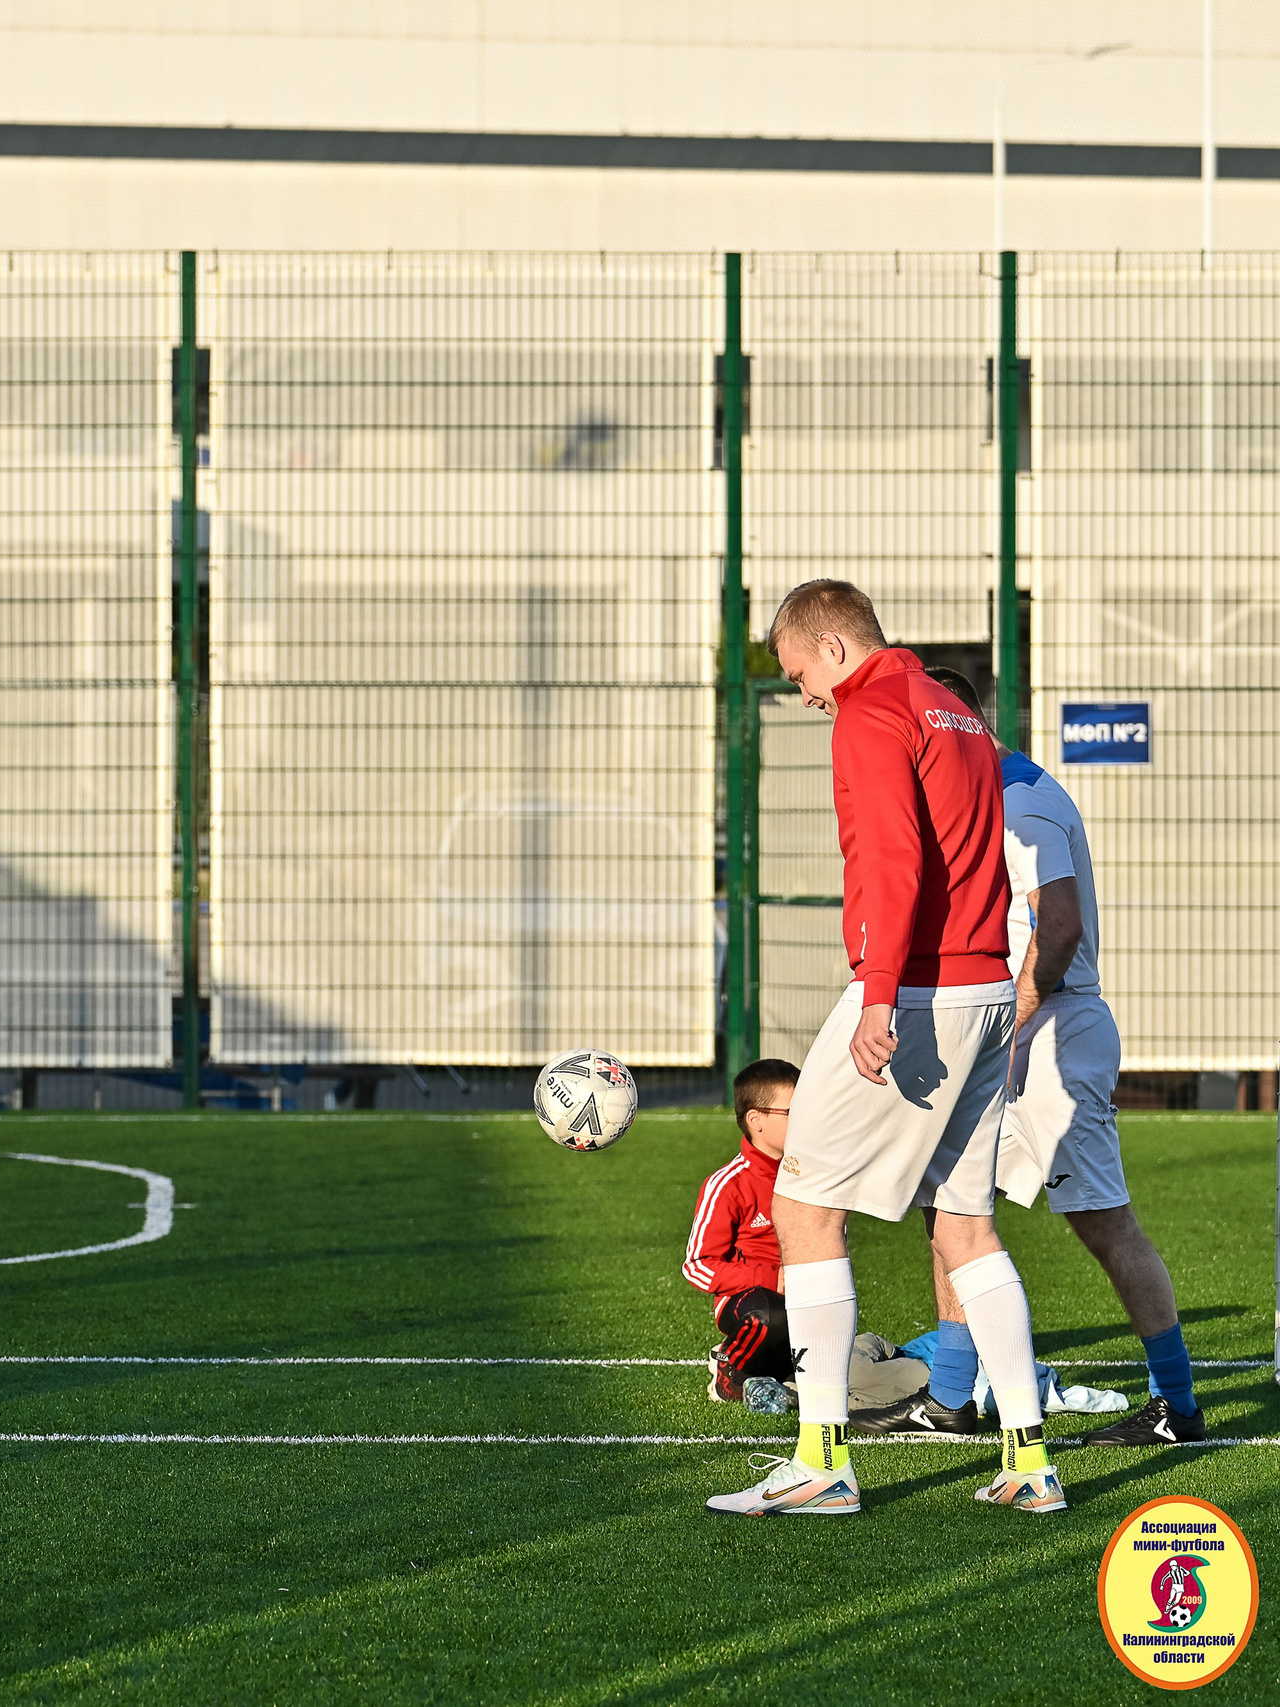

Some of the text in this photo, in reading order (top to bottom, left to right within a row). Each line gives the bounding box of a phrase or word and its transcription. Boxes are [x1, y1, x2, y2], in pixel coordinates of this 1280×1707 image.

[1063, 723, 1111, 743] МФП
[546, 1076, 574, 1108] mitre
[750, 1220, 771, 1228] adidas
